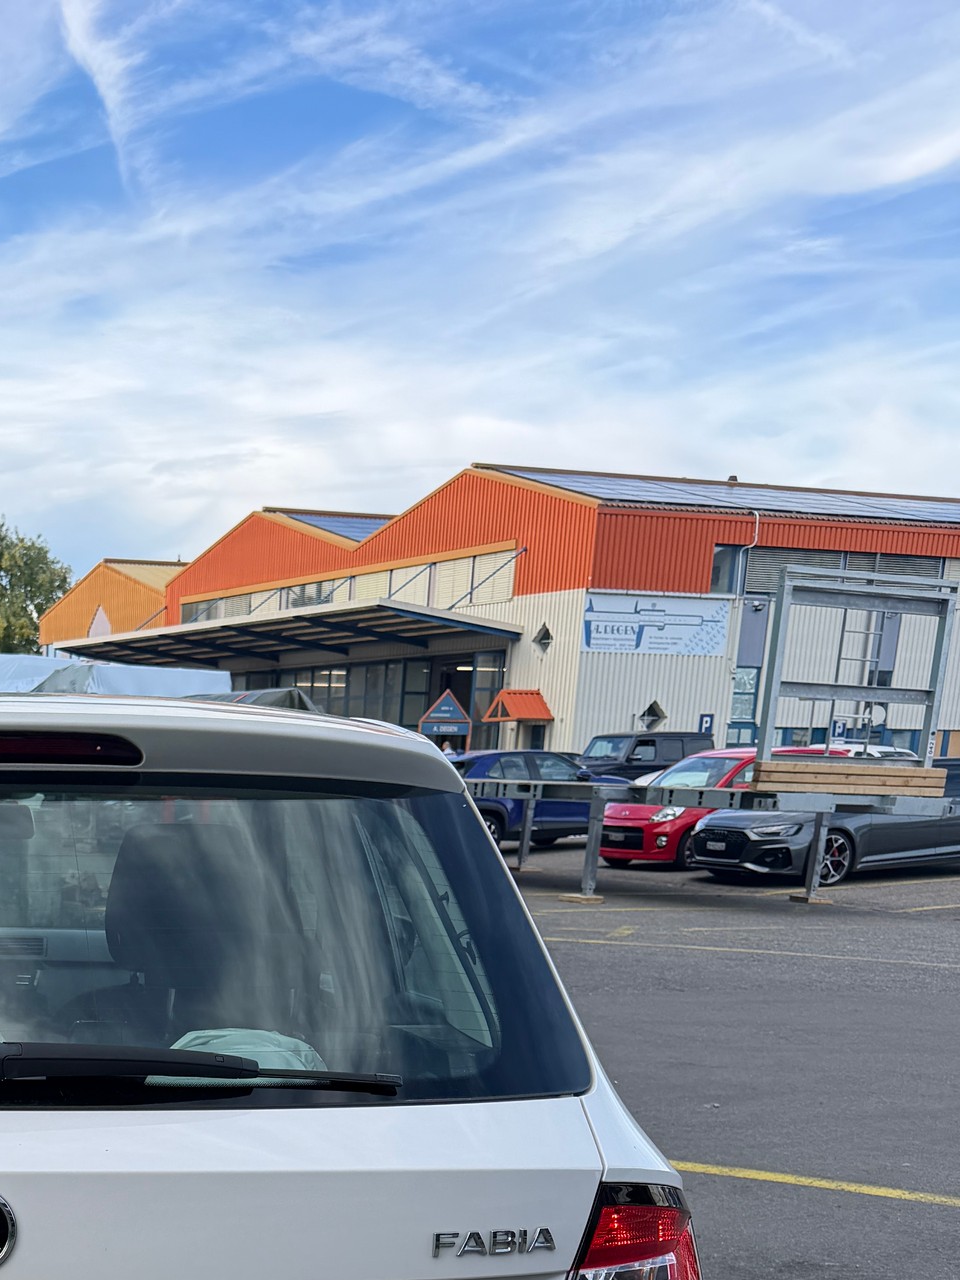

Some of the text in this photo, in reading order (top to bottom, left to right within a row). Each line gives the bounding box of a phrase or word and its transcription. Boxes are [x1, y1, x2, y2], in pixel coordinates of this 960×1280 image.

[604, 625, 637, 635] DEGEN
[701, 716, 711, 733] P
[834, 722, 844, 737] P
[432, 1226, 557, 1258] FABIA
